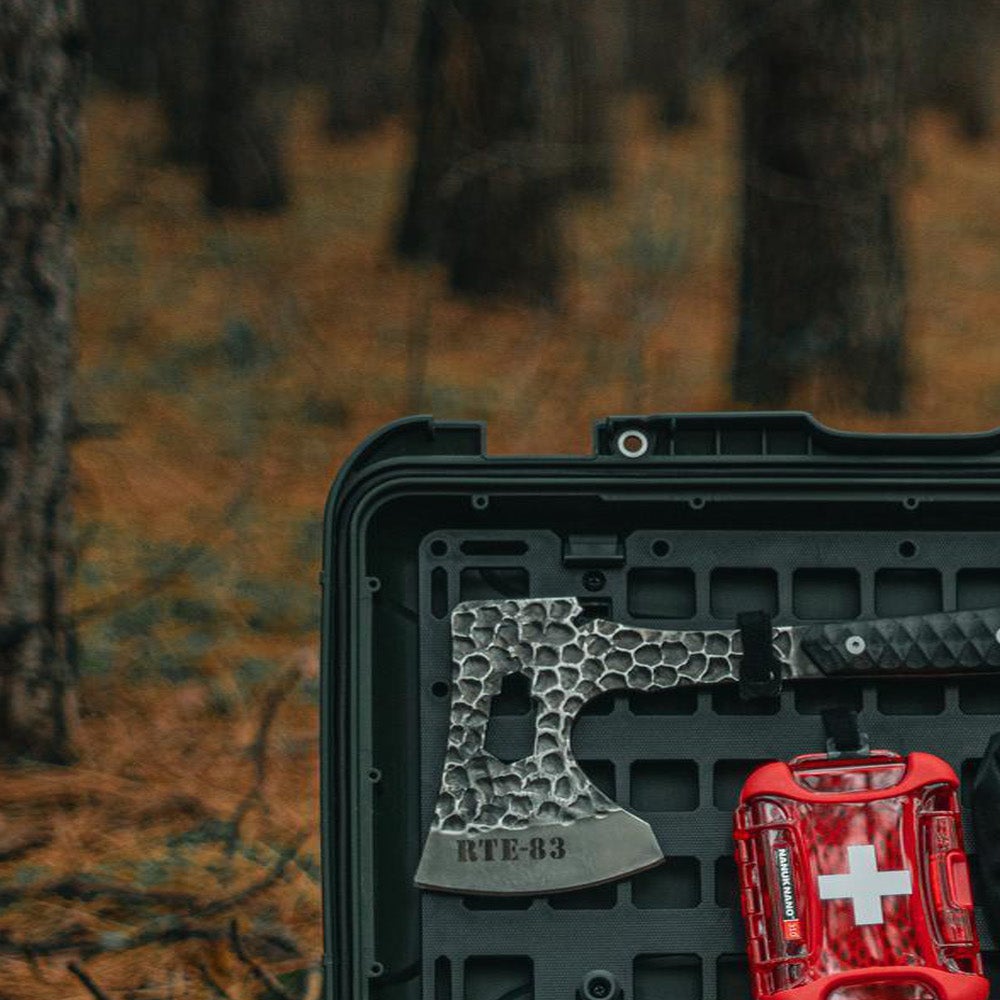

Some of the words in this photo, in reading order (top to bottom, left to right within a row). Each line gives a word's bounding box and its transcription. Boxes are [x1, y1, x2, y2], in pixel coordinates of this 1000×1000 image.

[457, 837, 566, 862] RTE-83
[778, 848, 792, 885] NANUK
[783, 886, 795, 917] NANO
